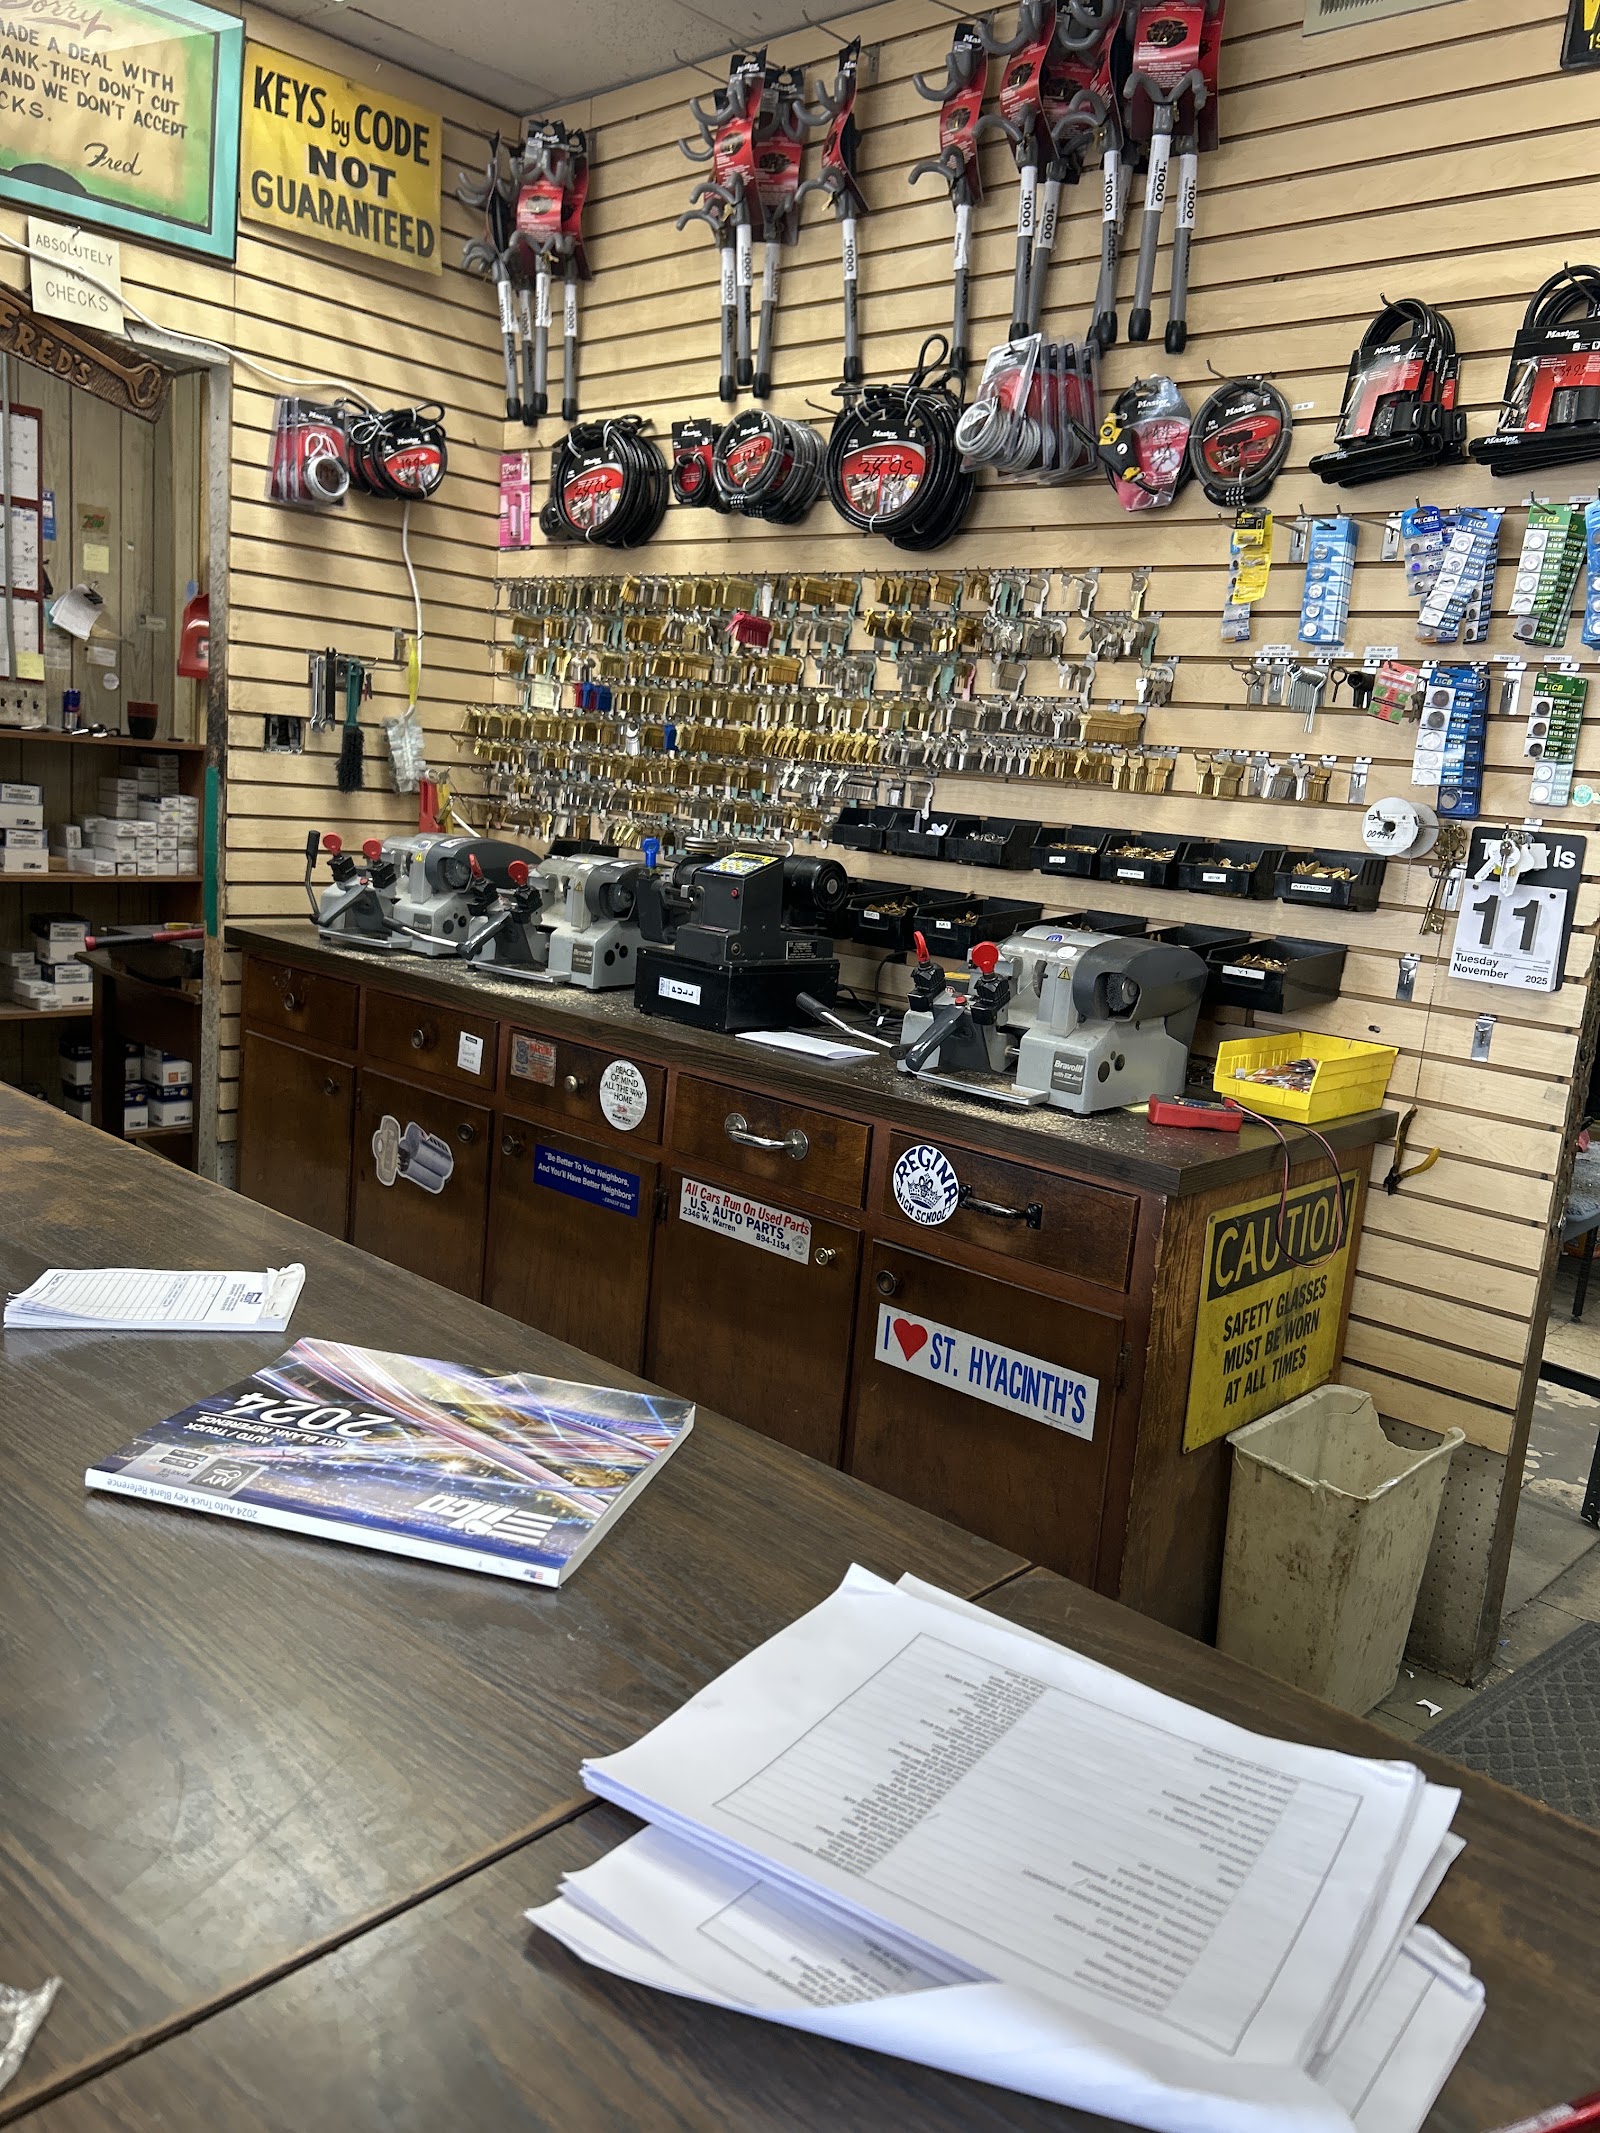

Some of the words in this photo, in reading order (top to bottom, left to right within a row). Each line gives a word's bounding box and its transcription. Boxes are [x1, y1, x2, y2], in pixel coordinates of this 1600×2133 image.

[47, 37, 60, 54] A
[68, 43, 113, 72] DEAL
[122, 60, 174, 93] WITH
[1, 68, 36, 91] AND
[42, 79, 68, 103] WE
[77, 91, 125, 121] DON'T
[134, 110, 188, 139] ACCEPT
[99, 77, 145, 104] DON'T
[151, 95, 180, 115] CUT
[253, 66, 327, 129] KEYS
[331, 109, 350, 147] by
[354, 105, 430, 166] CODE
[84, 142, 143, 176] Fred
[309, 145, 396, 197] NOT
[251, 170, 435, 258] GUARANTEED
[35, 234, 113, 267] ABSOLUTELY
[45, 281, 109, 313] CHECKS
[1553, 845, 1576, 869] Is
[1291, 882, 1331, 891] ARROW
[1472, 893, 1543, 954] 11
[1453, 963, 1509, 979] November
[1455, 952, 1499, 968] Tuesday
[671, 985, 694, 997] PULL
[1525, 975, 1548, 985] 2025
[611, 1073, 619, 1082] OF
[620, 1076, 639, 1088] MIND
[615, 1066, 635, 1078] PEACE
[604, 1081, 615, 1091] ALL
[616, 1083, 629, 1095] THE
[630, 1087, 644, 1099] WAY
[614, 1092, 633, 1105] HOME
[538, 1162, 550, 1173] And
[567, 1171, 582, 1184] Have
[582, 1176, 601, 1190] Better
[556, 1155, 574, 1168] Better
[574, 1161, 583, 1171] To
[583, 1163, 597, 1175] Your
[597, 1168, 630, 1188] Neighbors,
[896, 1145, 958, 1208] REGINA
[682, 1206, 701, 1220] 2346
[701, 1212, 711, 1223] W.
[712, 1215, 736, 1232] Warren
[684, 1182, 698, 1197] All
[700, 1188, 721, 1205] Cars
[722, 1196, 742, 1212] Run
[743, 1202, 757, 1216] On
[758, 1206, 782, 1227] Used
[783, 1216, 810, 1236] Parts
[689, 1197, 710, 1215] U.S.
[712, 1204, 743, 1226] AUTO
[745, 1216, 784, 1240] PARTS
[914, 1208, 947, 1224] SCHOOL
[755, 1232, 790, 1252] 894-1194
[1215, 1188, 1351, 1289] CAUTION
[1222, 1298, 1274, 1343] SAFETY
[1275, 1274, 1329, 1316] GLASSES
[1222, 1336, 1264, 1376] MUST
[1264, 1326, 1283, 1357] BE
[1283, 1308, 1322, 1343] WORN
[884, 1315, 891, 1350] I
[930, 1332, 958, 1377] ST.
[968, 1346, 1087, 1424] HYACINTH'S
[1223, 1378, 1241, 1409] AT
[1243, 1365, 1267, 1401] ALL
[1272, 1345, 1309, 1383] TIMES
[222, 1391, 396, 1437] 2024
[183, 1421, 228, 1438] TRUCK
[196, 1414, 288, 1440] REFERENCE
[236, 1430, 275, 1446] AUTO
[287, 1429, 319, 1444] BLANK
[325, 1437, 347, 1448] KEY
[106, 1478, 149, 1496] Reference
[148, 1485, 173, 1500] Blank
[202, 1474, 232, 1488] MY
[172, 1490, 190, 1505] Key
[189, 1495, 214, 1511] Truck
[214, 1501, 236, 1514] Auto
[235, 1507, 258, 1520] 2024
